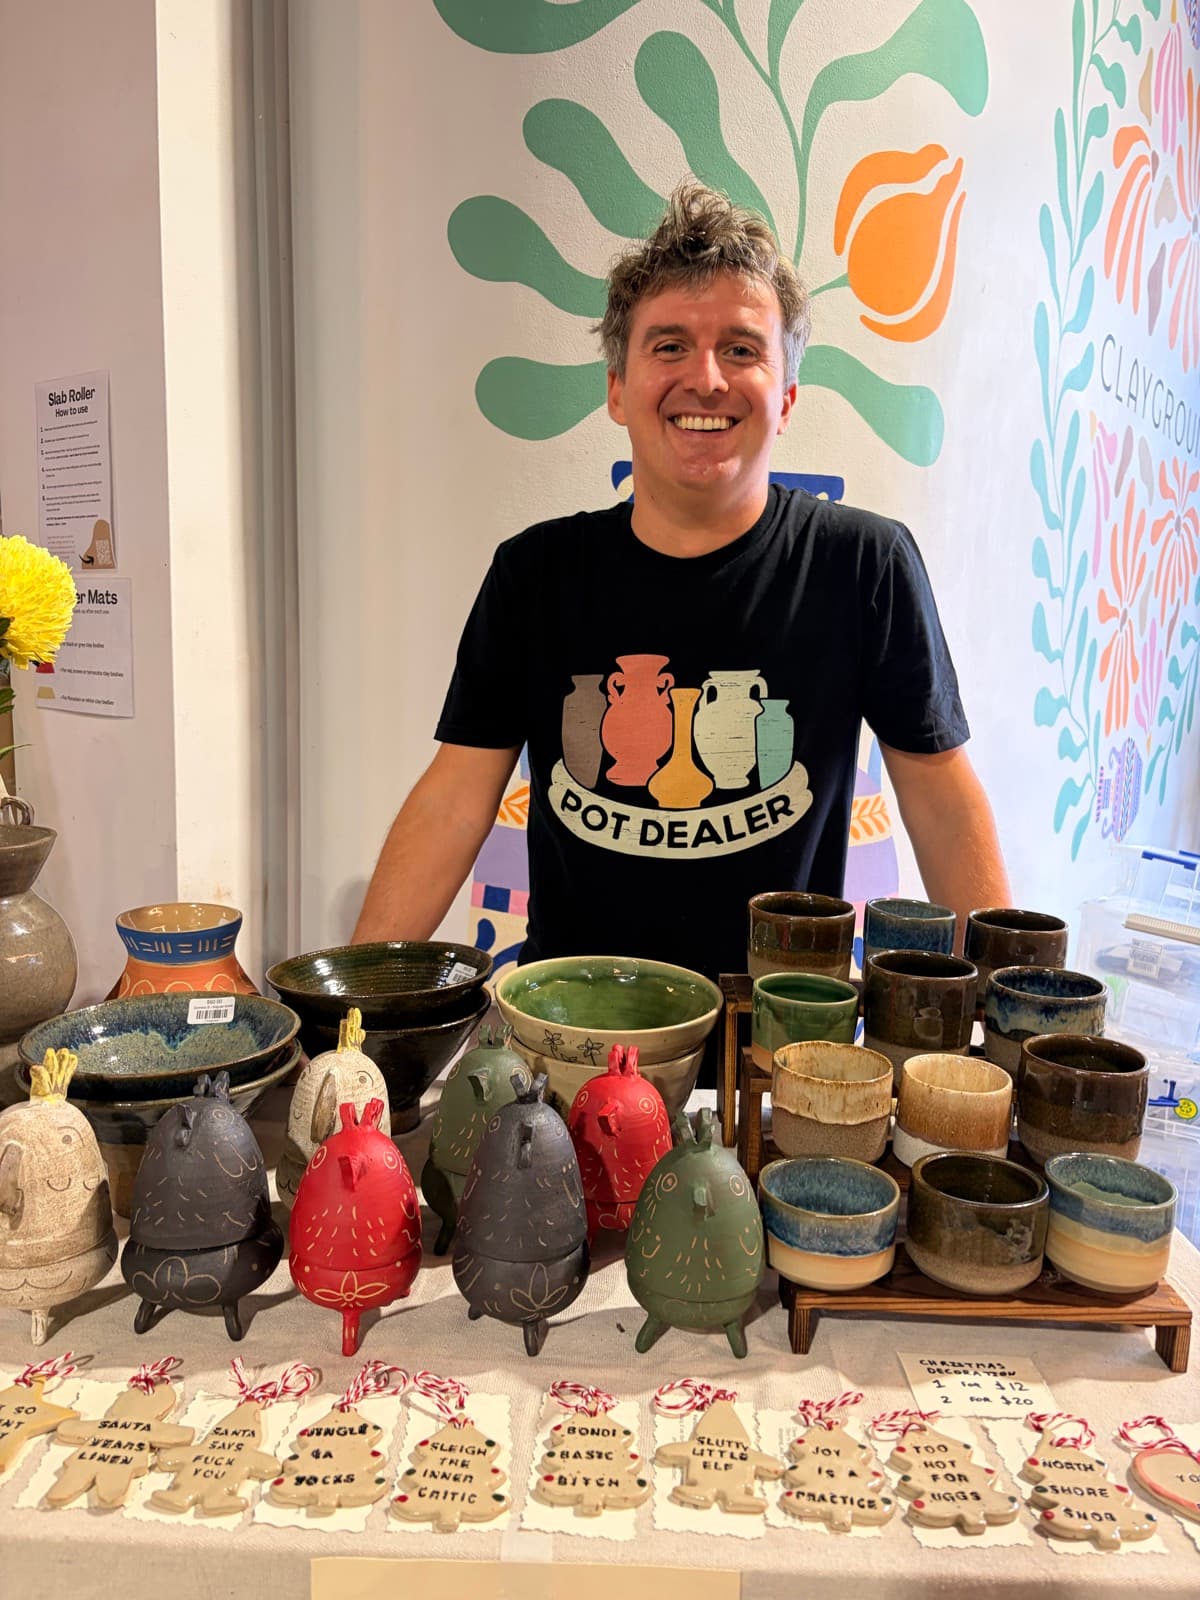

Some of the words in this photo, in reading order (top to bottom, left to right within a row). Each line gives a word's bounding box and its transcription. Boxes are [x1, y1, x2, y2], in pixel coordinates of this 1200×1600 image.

[48, 390, 67, 406] Slab
[69, 386, 95, 402] Roller
[55, 408, 68, 417] How
[70, 407, 77, 415] to
[78, 405, 88, 414] use
[88, 589, 118, 605] Mats
[561, 789, 630, 840] POT
[639, 794, 795, 848] DEALER
[919, 1359, 1006, 1370] CHRISTMAS
[927, 1368, 1016, 1377] DECORATION
[932, 1379, 945, 1388] 1
[995, 1381, 1030, 1391] $12
[940, 1396, 952, 1404] 2
[1000, 1395, 1034, 1406] $20
[13, 1406, 37, 1415] SO
[98, 1420, 151, 1432] SANTA
[306, 1423, 368, 1437] JINGLE
[567, 1426, 616, 1437] BONDI
[211, 1427, 256, 1438] SANTA
[208, 1441, 244, 1452] SAYS
[430, 1442, 487, 1456] SLEIGH
[696, 1436, 749, 1451] SLUTTY
[912, 1444, 948, 1454] TOO
[560, 1450, 613, 1460] BASIC
[692, 1448, 748, 1461] LITTLE
[812, 1446, 840, 1456] JOY
[78, 1451, 134, 1465] LINEN
[192, 1455, 235, 1466] FUCK
[440, 1457, 471, 1469] THE
[703, 1461, 733, 1471] ELF
[923, 1460, 956, 1469] HOT
[1042, 1460, 1095, 1472] NORTH
[193, 1468, 226, 1479] YOU
[422, 1469, 474, 1483] INNER
[818, 1466, 834, 1478] IS
[848, 1469, 858, 1478] A
[931, 1472, 969, 1482] FOR
[558, 1475, 619, 1487] BITCH
[418, 1487, 477, 1504] CRITIC
[931, 1491, 981, 1502] UGGS
[1048, 1485, 1109, 1498] SHORE
[796, 1491, 877, 1509] PRACTICE
[1063, 1507, 1117, 1522] SNOB
